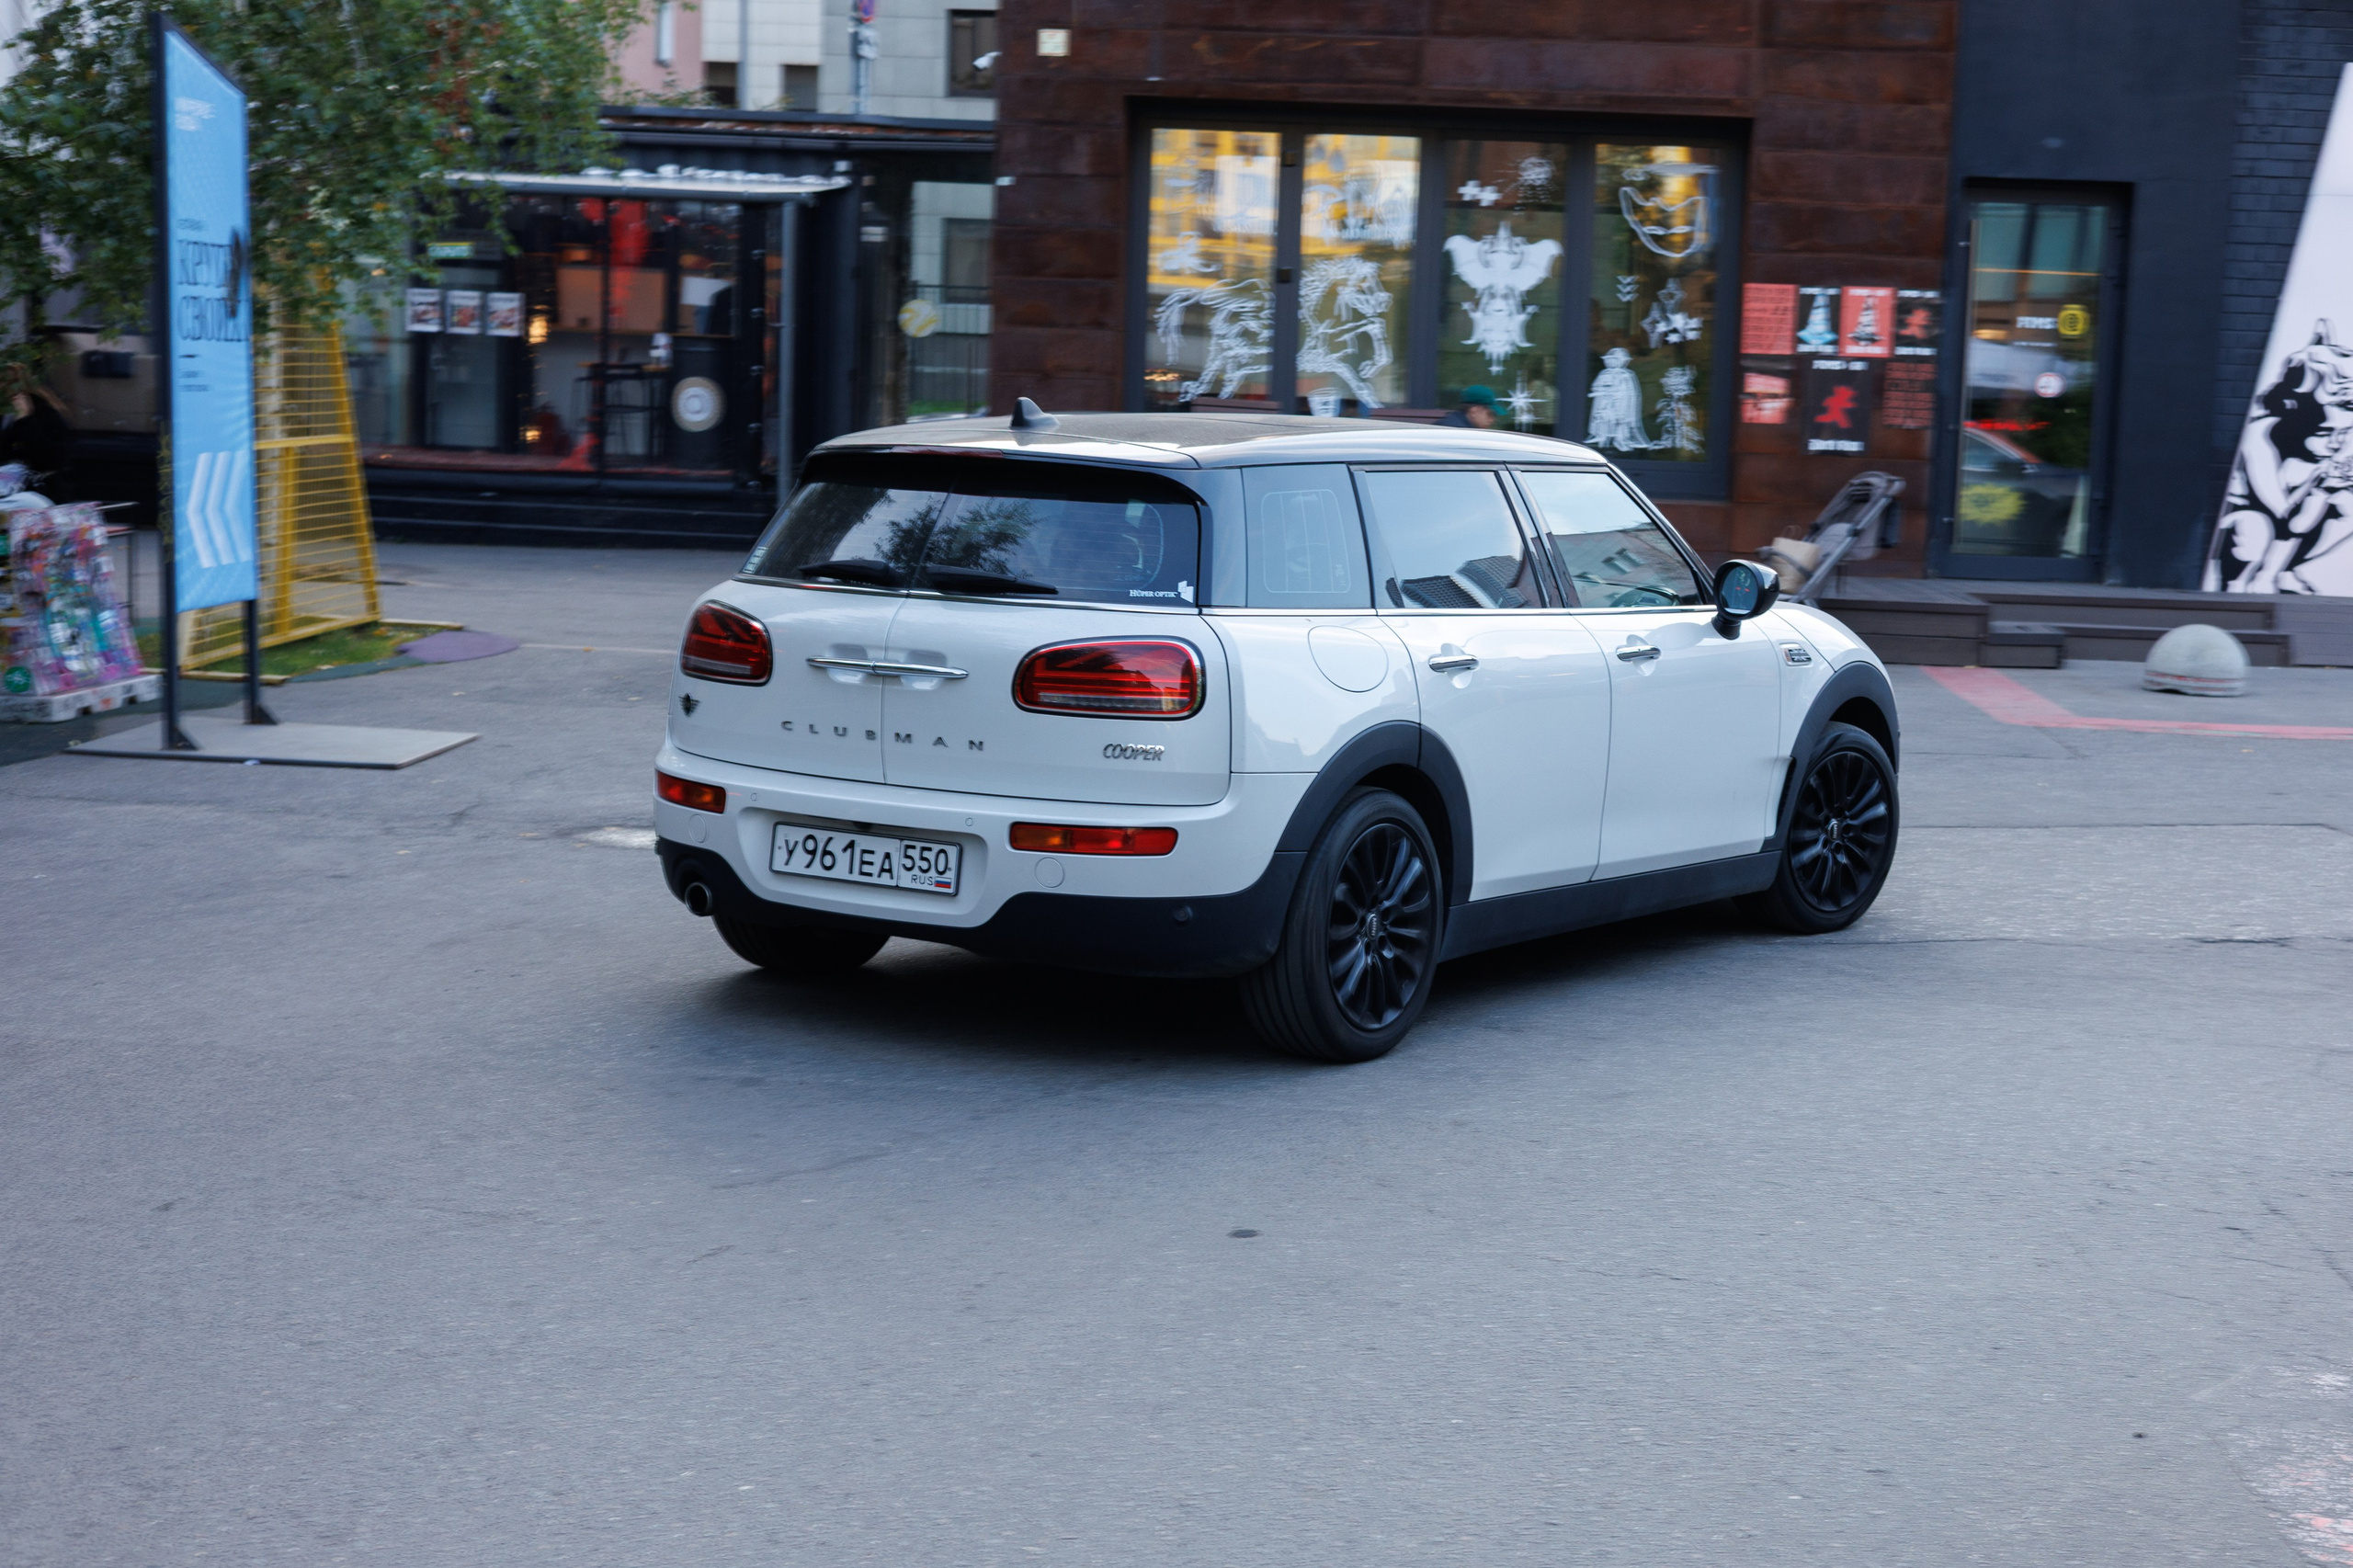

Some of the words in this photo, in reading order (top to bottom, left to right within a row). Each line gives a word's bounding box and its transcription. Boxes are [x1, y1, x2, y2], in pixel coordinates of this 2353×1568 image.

[780, 721, 984, 752] CLUBMAN
[1103, 743, 1165, 761] COOPER
[902, 844, 949, 875] 550
[910, 873, 934, 886] RUS
